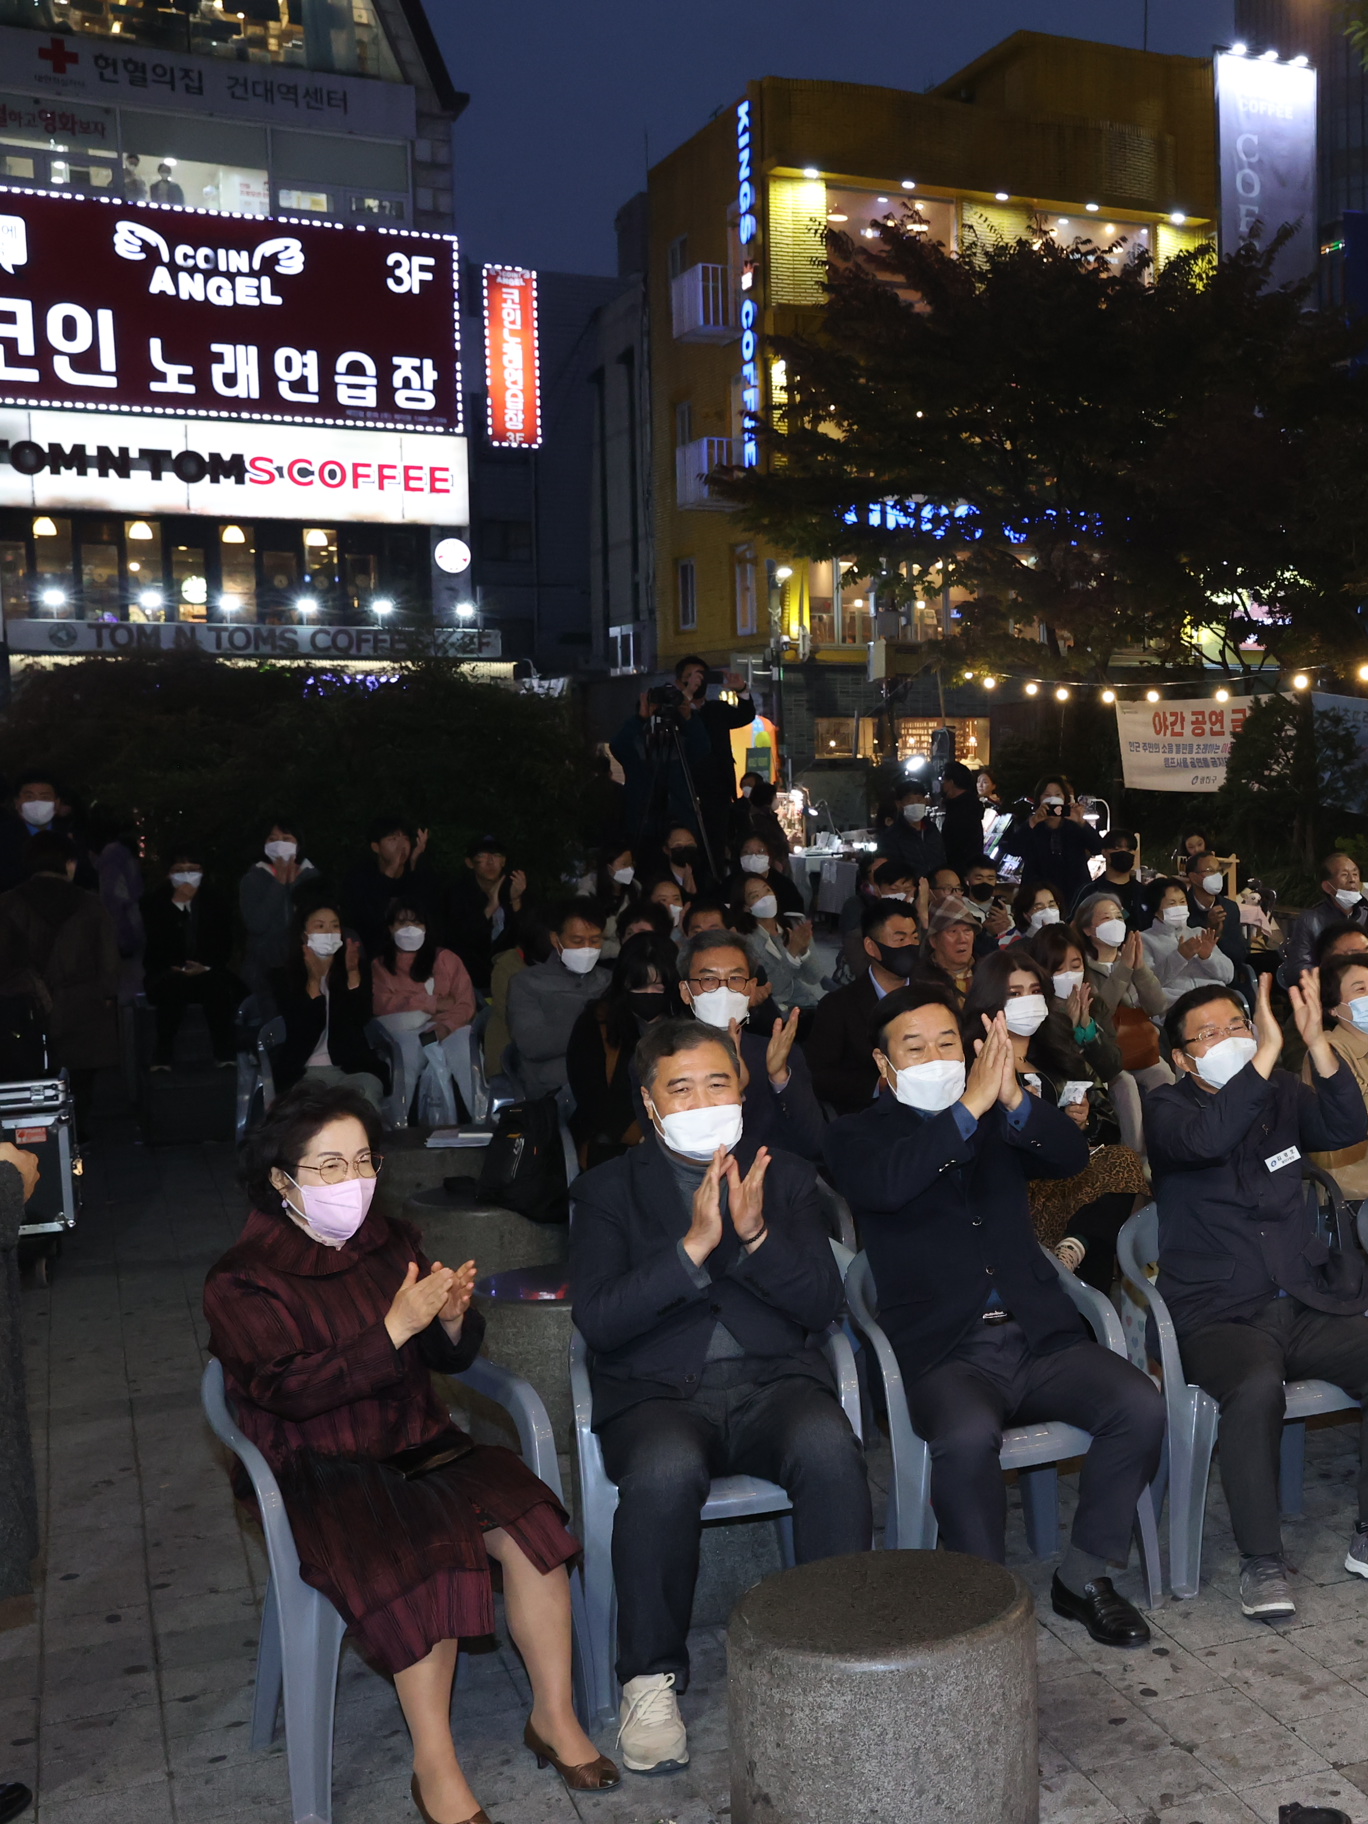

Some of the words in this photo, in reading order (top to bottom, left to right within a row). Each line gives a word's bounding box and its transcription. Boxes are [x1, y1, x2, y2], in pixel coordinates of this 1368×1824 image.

[93, 53, 204, 96] 헌혈의집
[226, 75, 348, 115] 건대역센터
[737, 100, 756, 245] KINGS
[174, 244, 249, 273] COIN
[386, 253, 436, 295] 3F
[149, 266, 283, 307] ANGEL
[149, 337, 438, 411] 노래연습장
[0, 439, 88, 477] OM
[97, 445, 131, 480] N
[287, 458, 450, 494] COFFEE
[1152, 711, 1186, 738] 야간
[1190, 710, 1226, 737] 공연
